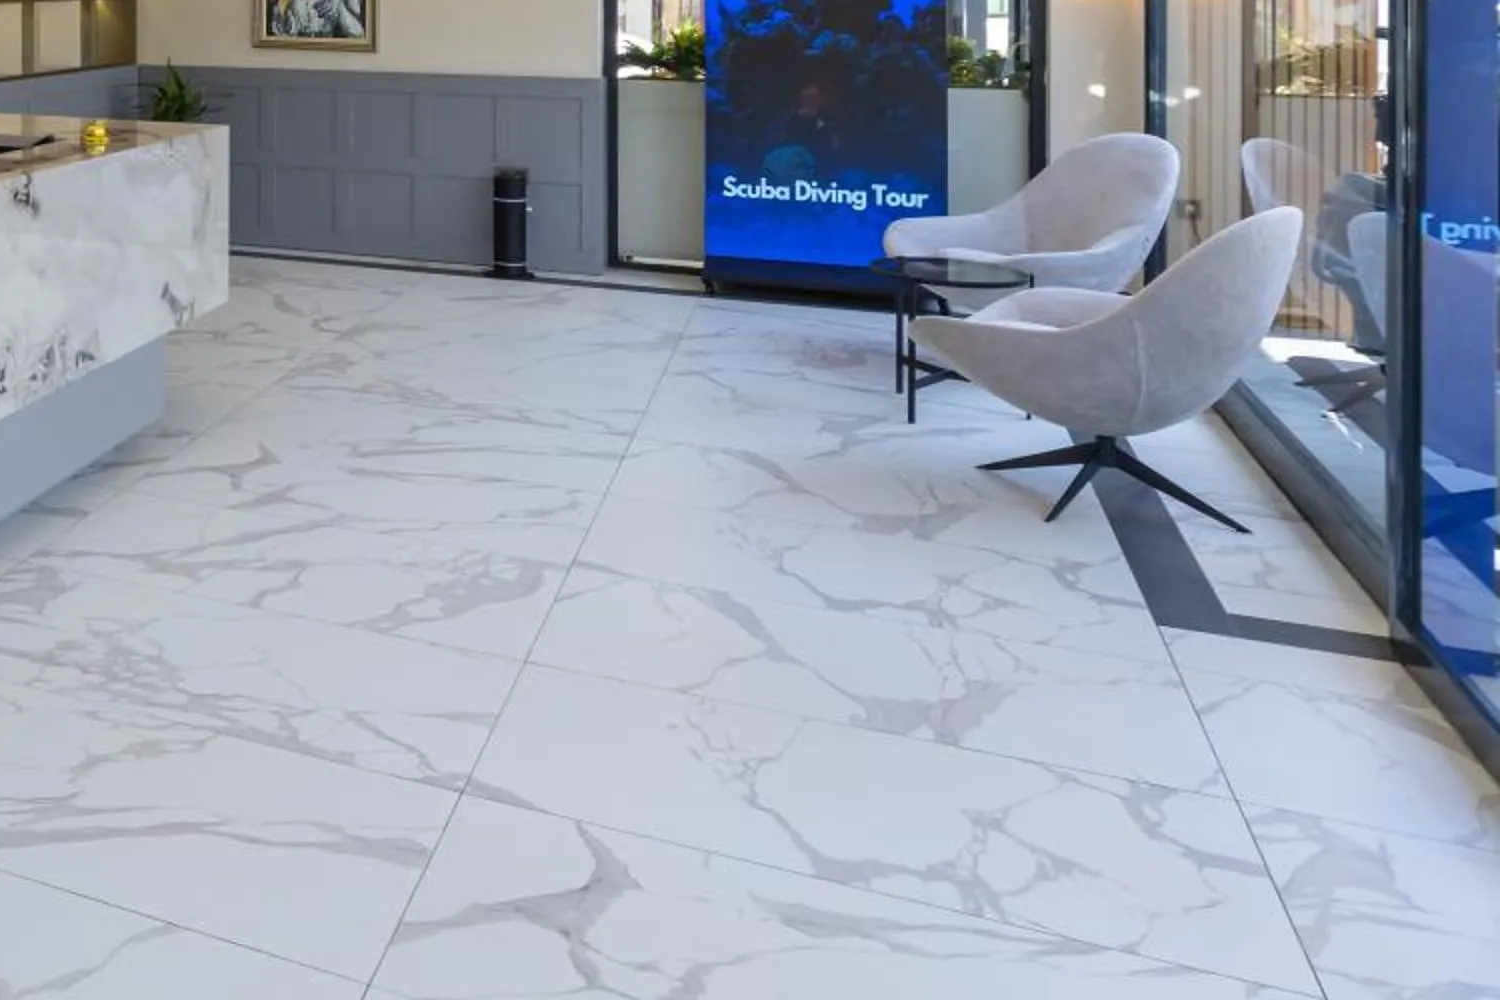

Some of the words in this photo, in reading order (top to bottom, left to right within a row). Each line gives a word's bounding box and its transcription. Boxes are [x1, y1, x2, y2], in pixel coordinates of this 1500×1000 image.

[723, 175, 790, 200] Scuba
[795, 179, 867, 211] Diving
[871, 183, 929, 209] Tour
